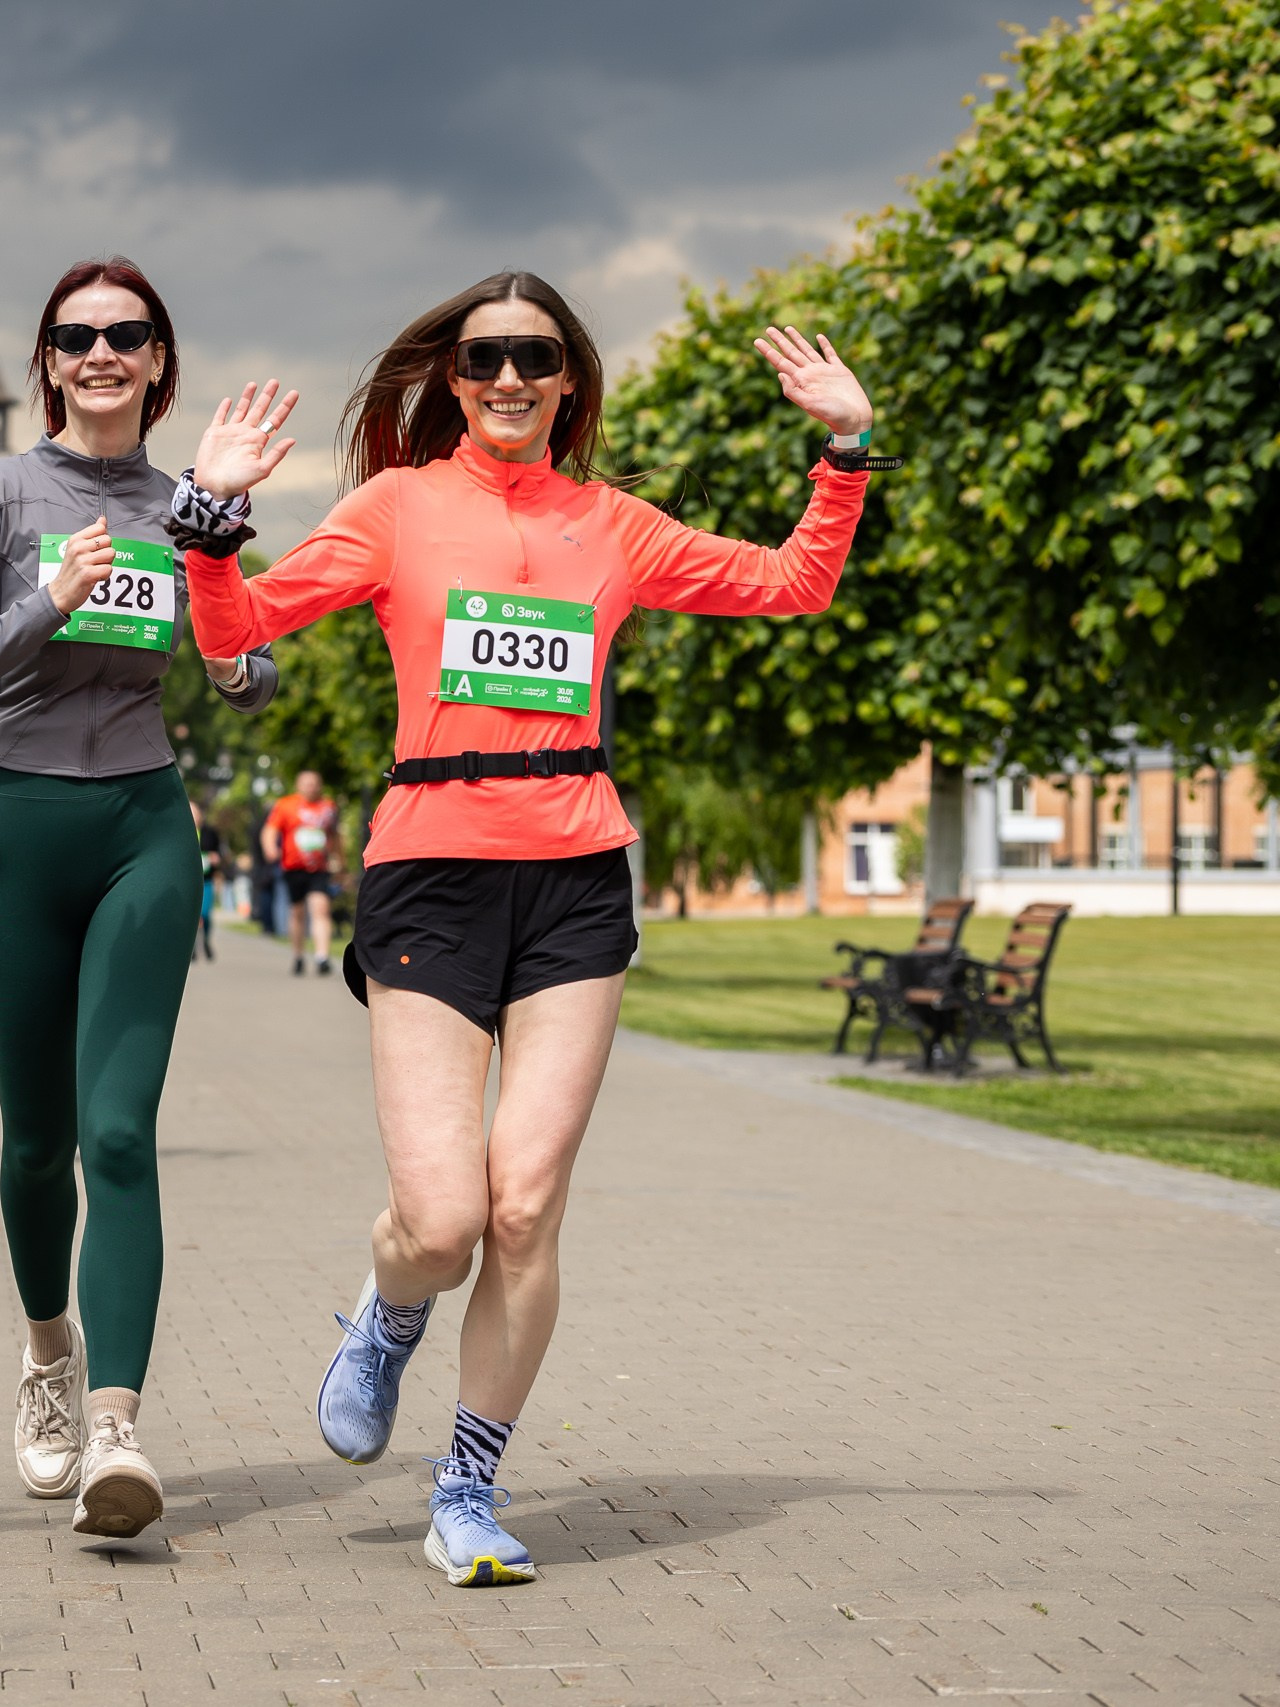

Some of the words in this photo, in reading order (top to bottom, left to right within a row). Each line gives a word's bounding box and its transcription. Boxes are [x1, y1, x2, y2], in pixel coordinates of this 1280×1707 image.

[115, 551, 134, 561] вук
[90, 574, 154, 610] 328
[470, 600, 483, 611] 4,2
[517, 606, 545, 620] Звук
[144, 625, 159, 633] 30.05
[144, 632, 157, 640] 2026
[472, 629, 568, 673] 0330
[556, 687, 574, 696] 30.05
[556, 695, 572, 704] 2026
